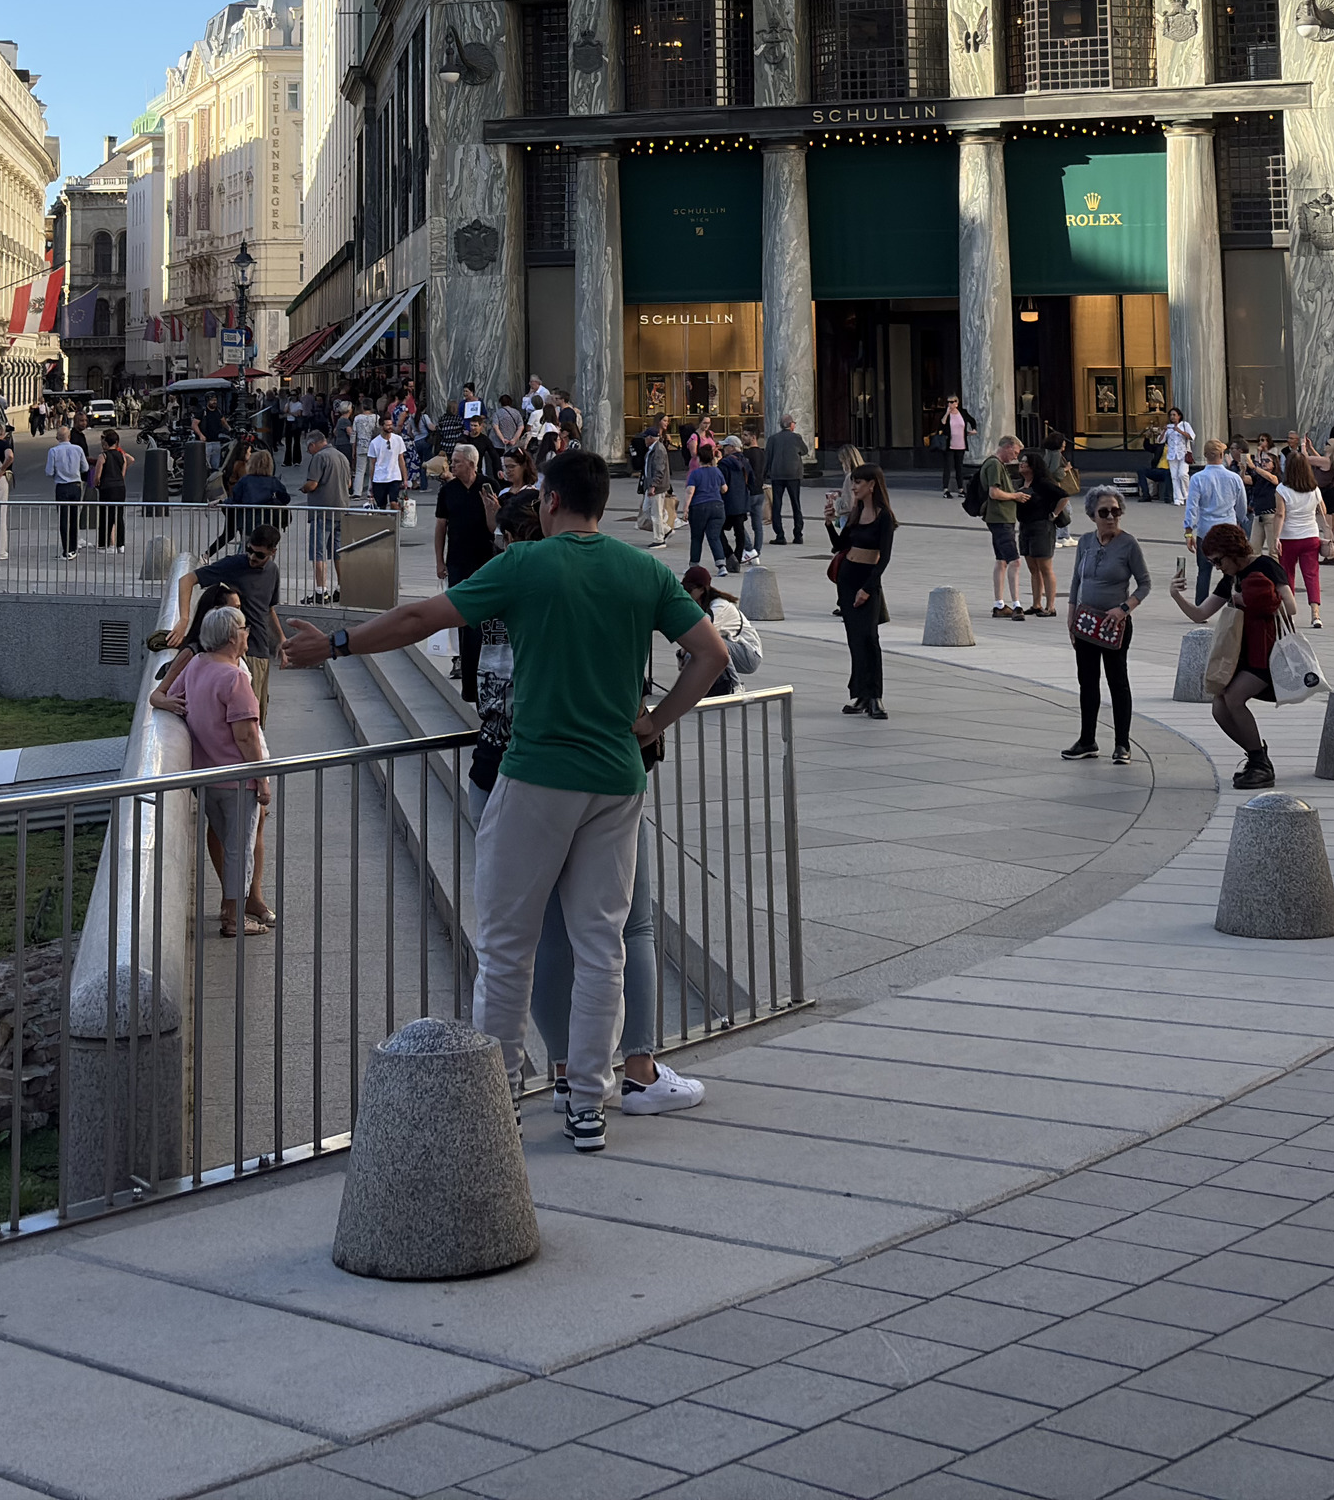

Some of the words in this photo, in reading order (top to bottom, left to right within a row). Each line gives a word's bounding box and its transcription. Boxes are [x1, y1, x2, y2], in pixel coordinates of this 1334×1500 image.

[812, 105, 937, 124] SCHULLIN
[271, 80, 281, 230] STEIGENBERGER
[673, 207, 726, 215] SCHULLIN
[1066, 213, 1123, 227] ROLEX
[639, 313, 734, 325] SCHULLIN
